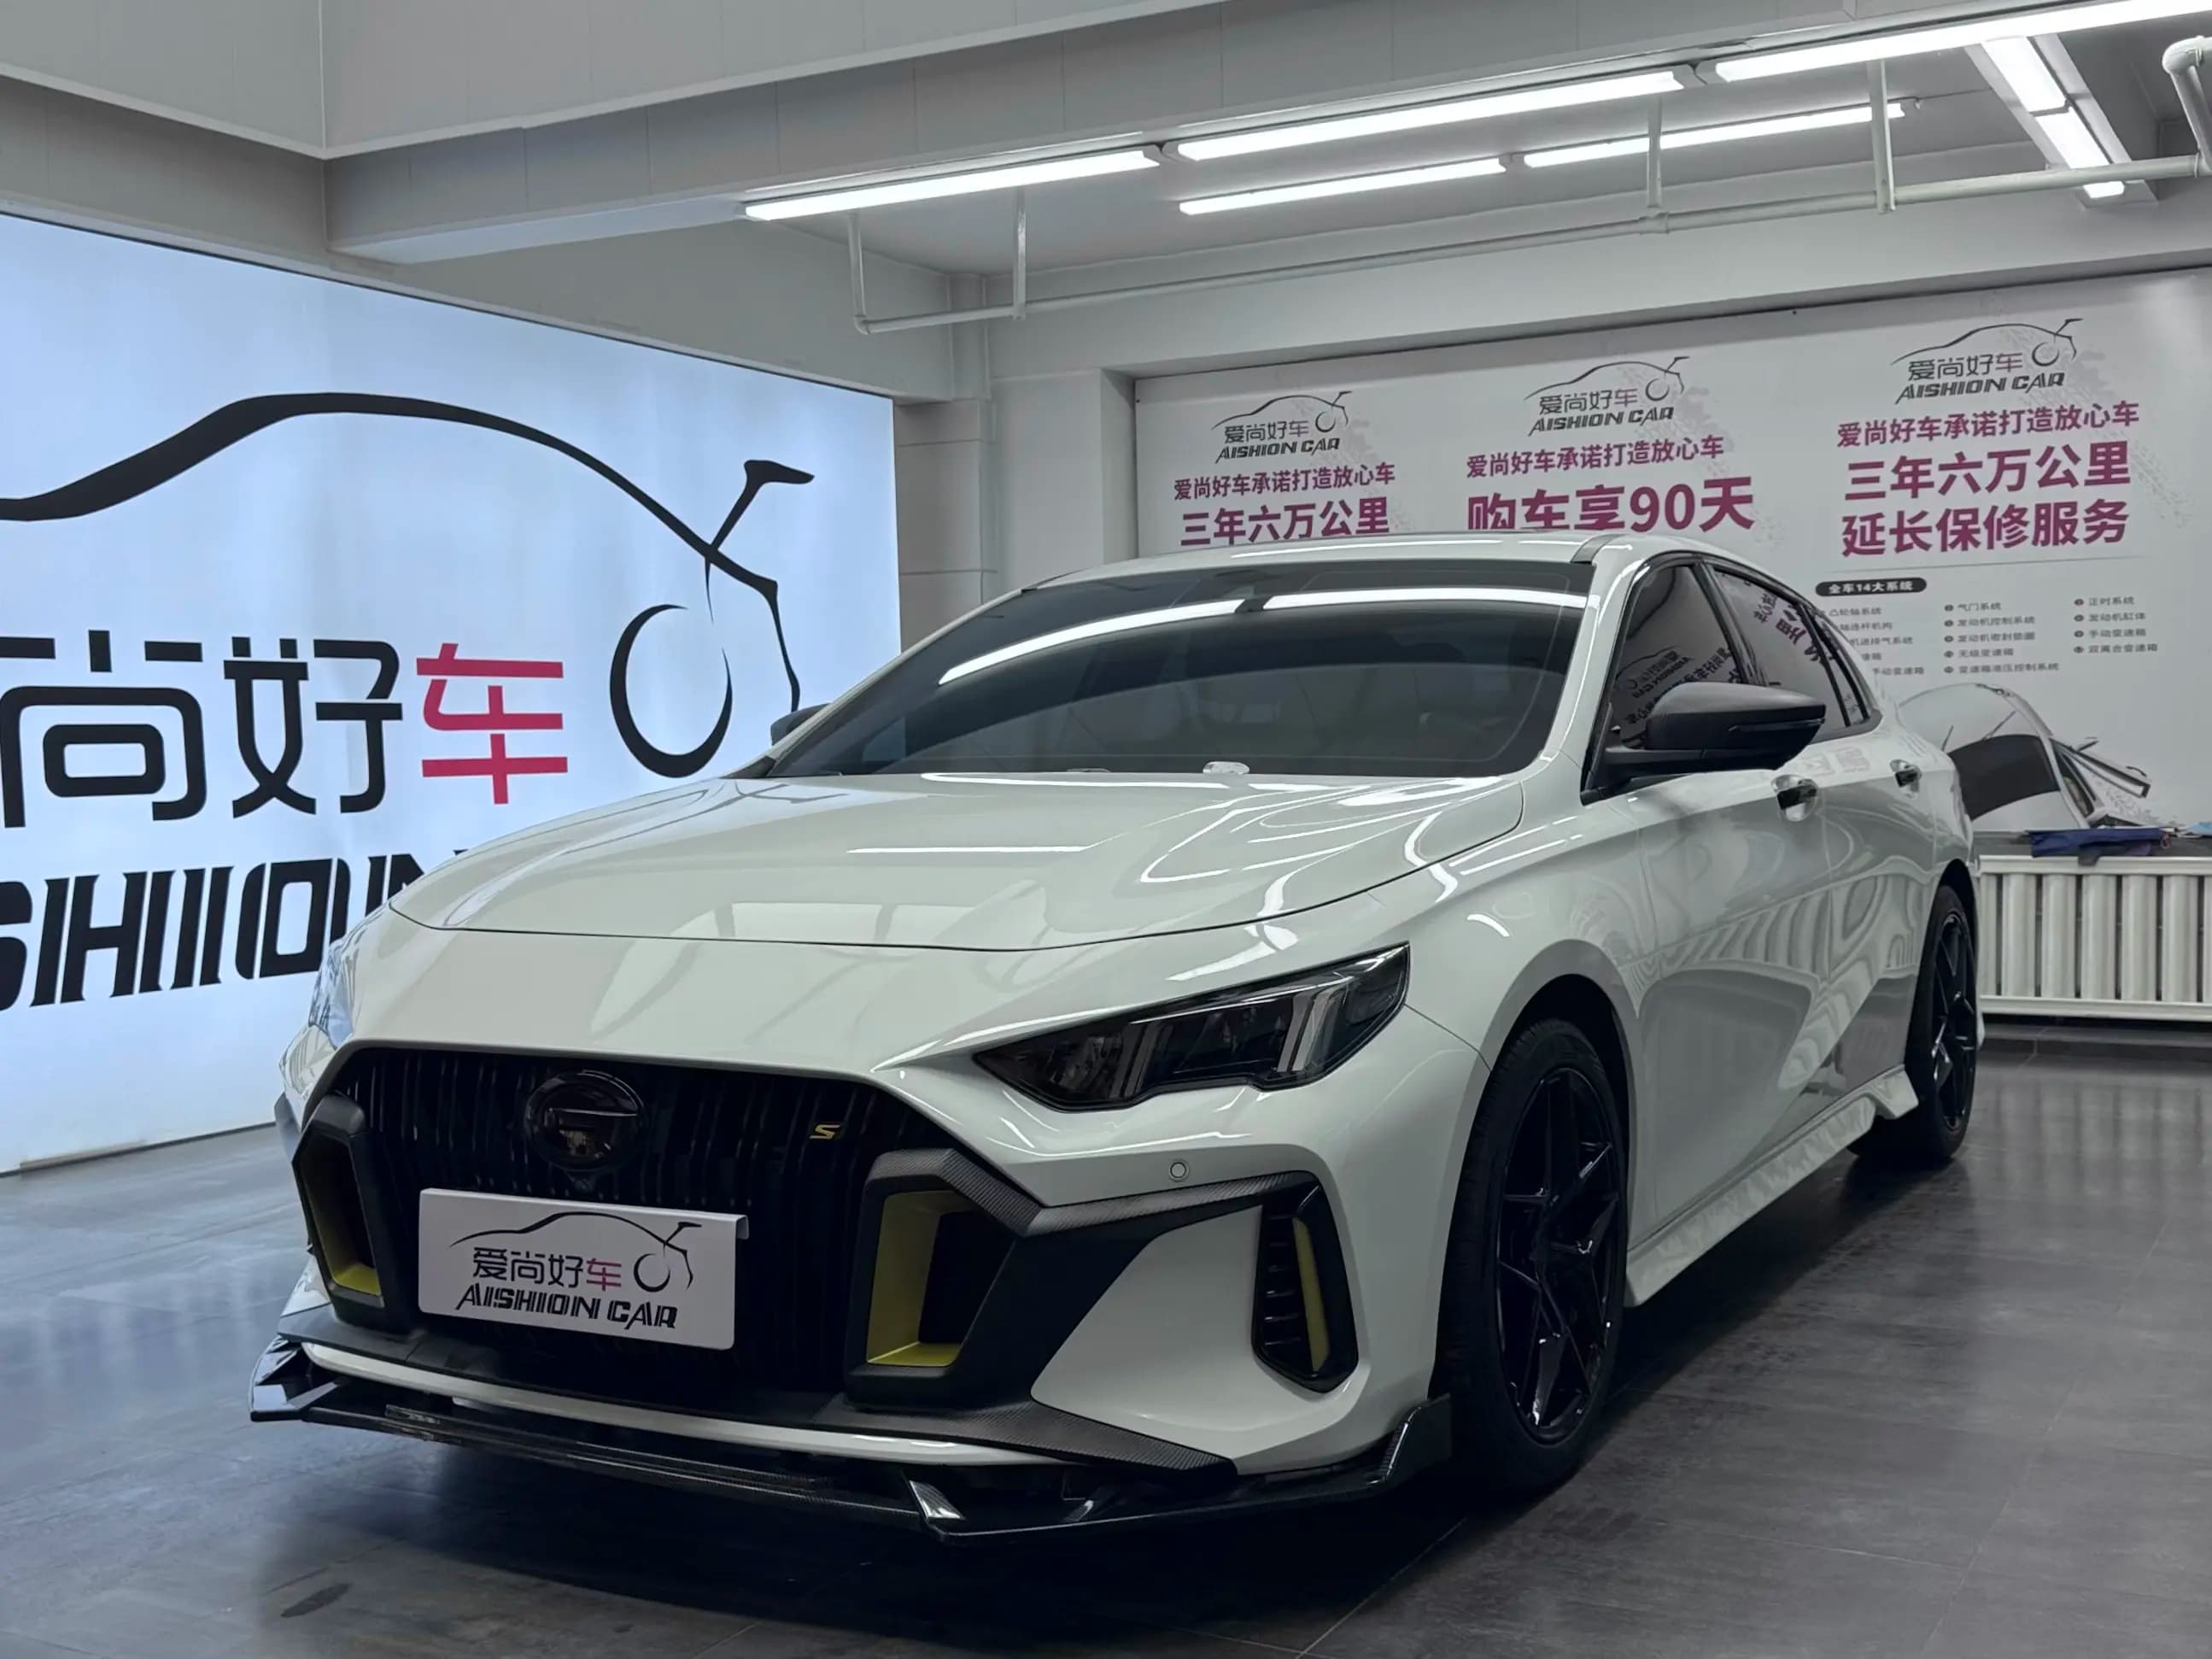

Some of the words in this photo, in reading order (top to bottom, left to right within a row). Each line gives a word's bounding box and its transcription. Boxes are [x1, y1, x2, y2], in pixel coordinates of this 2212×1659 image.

[1907, 353, 2023, 382] 爱尚好车
[1539, 387, 1638, 415] 爱尚好车
[1895, 376, 2006, 405] AISHION
[2010, 372, 2065, 394] CAR
[1224, 420, 1309, 444] 爱尚好车
[1528, 412, 1624, 437] AISHION
[1628, 407, 1674, 425] CAR
[1836, 400, 2139, 448] 爱尚好车承诺打造放心车
[1214, 442, 1297, 464] AISHION
[1301, 437, 1340, 455] CAR
[1466, 434, 1724, 478] 爱尚好车承诺打造放心车
[1845, 441, 2131, 501] 三年六万公里
[1173, 462, 1396, 501] 爱尚好车承诺打造放心车
[1180, 496, 1390, 546] 三年六万公里
[1467, 477, 1755, 533] 购车享90天
[1841, 498, 2129, 558] 延长保修服务
[809, 1123, 841, 1140] S
[472, 1246, 623, 1292] 爱尚好车
[455, 1282, 601, 1320] AISHION
[607, 1300, 678, 1330] CAR
